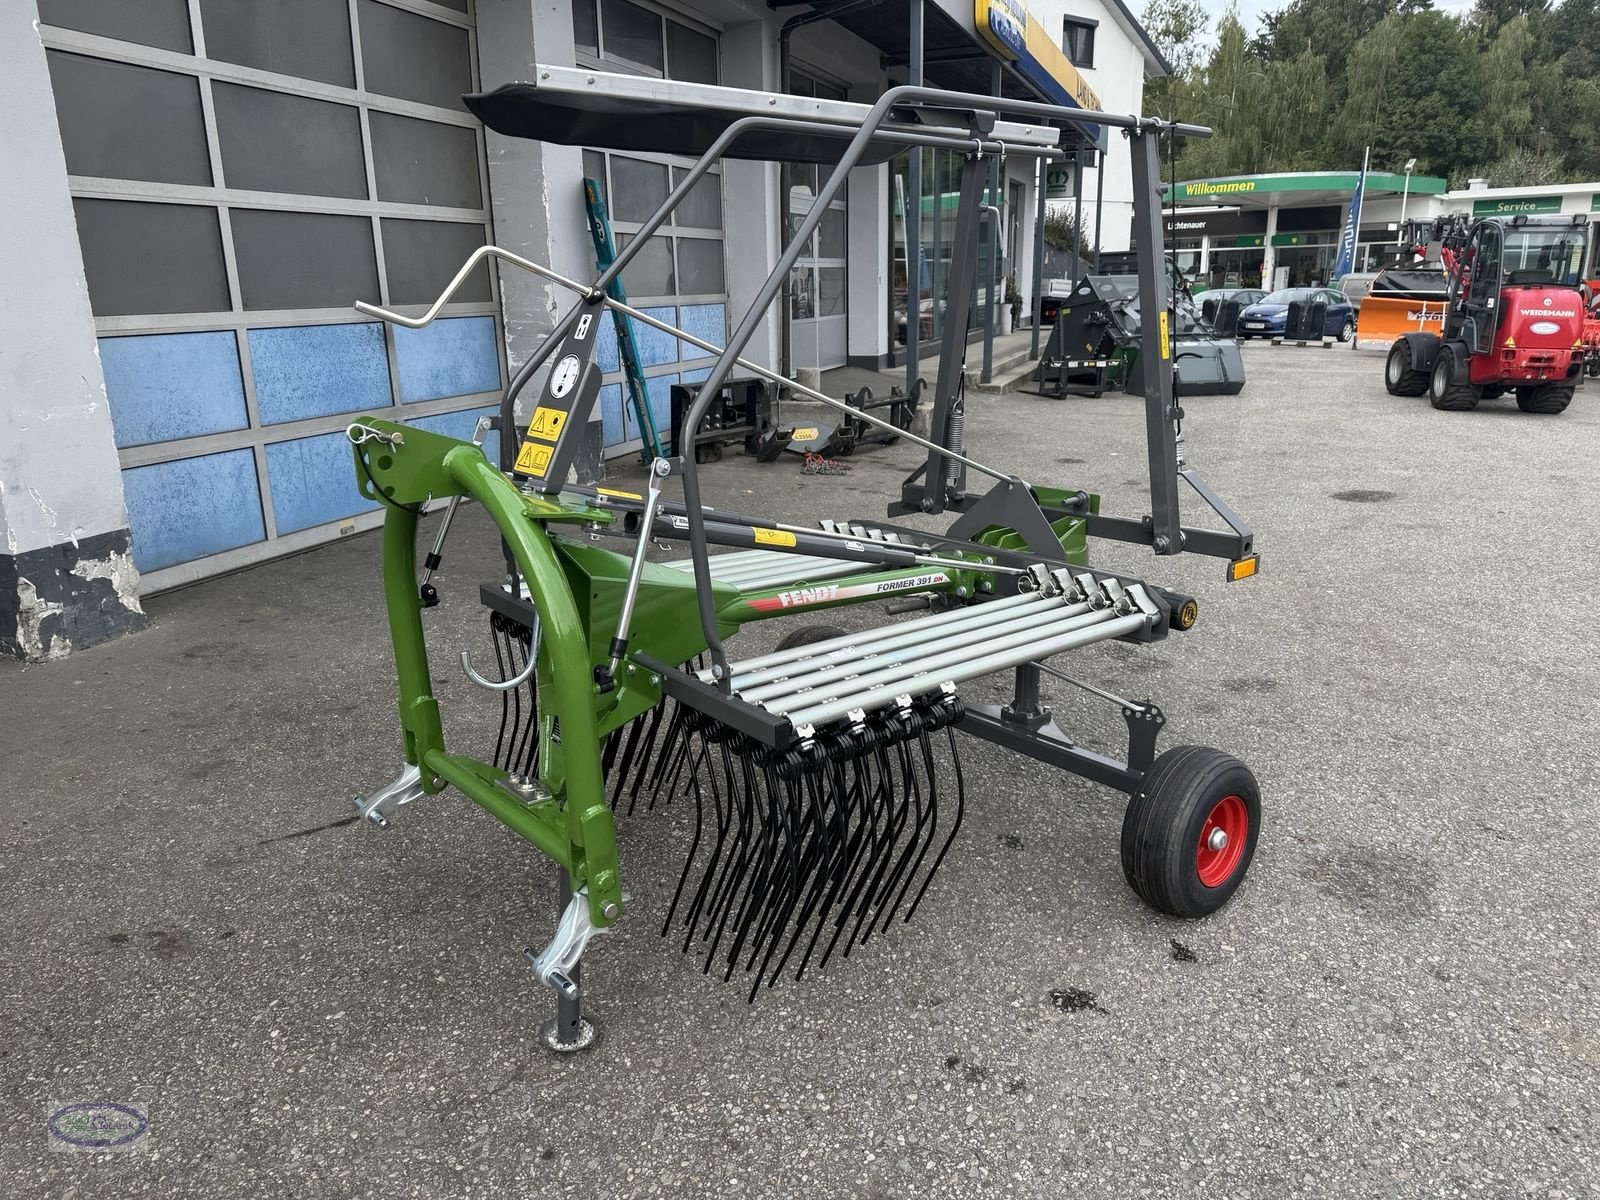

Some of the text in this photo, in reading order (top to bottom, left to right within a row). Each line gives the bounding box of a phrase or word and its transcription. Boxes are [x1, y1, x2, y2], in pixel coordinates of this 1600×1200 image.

[1186, 182, 1255, 195] Willkommen
[1497, 201, 1537, 212] Service
[1520, 309, 1576, 318] WEIDEMANN
[777, 575, 944, 608] FENDT FORMER 391 DN
